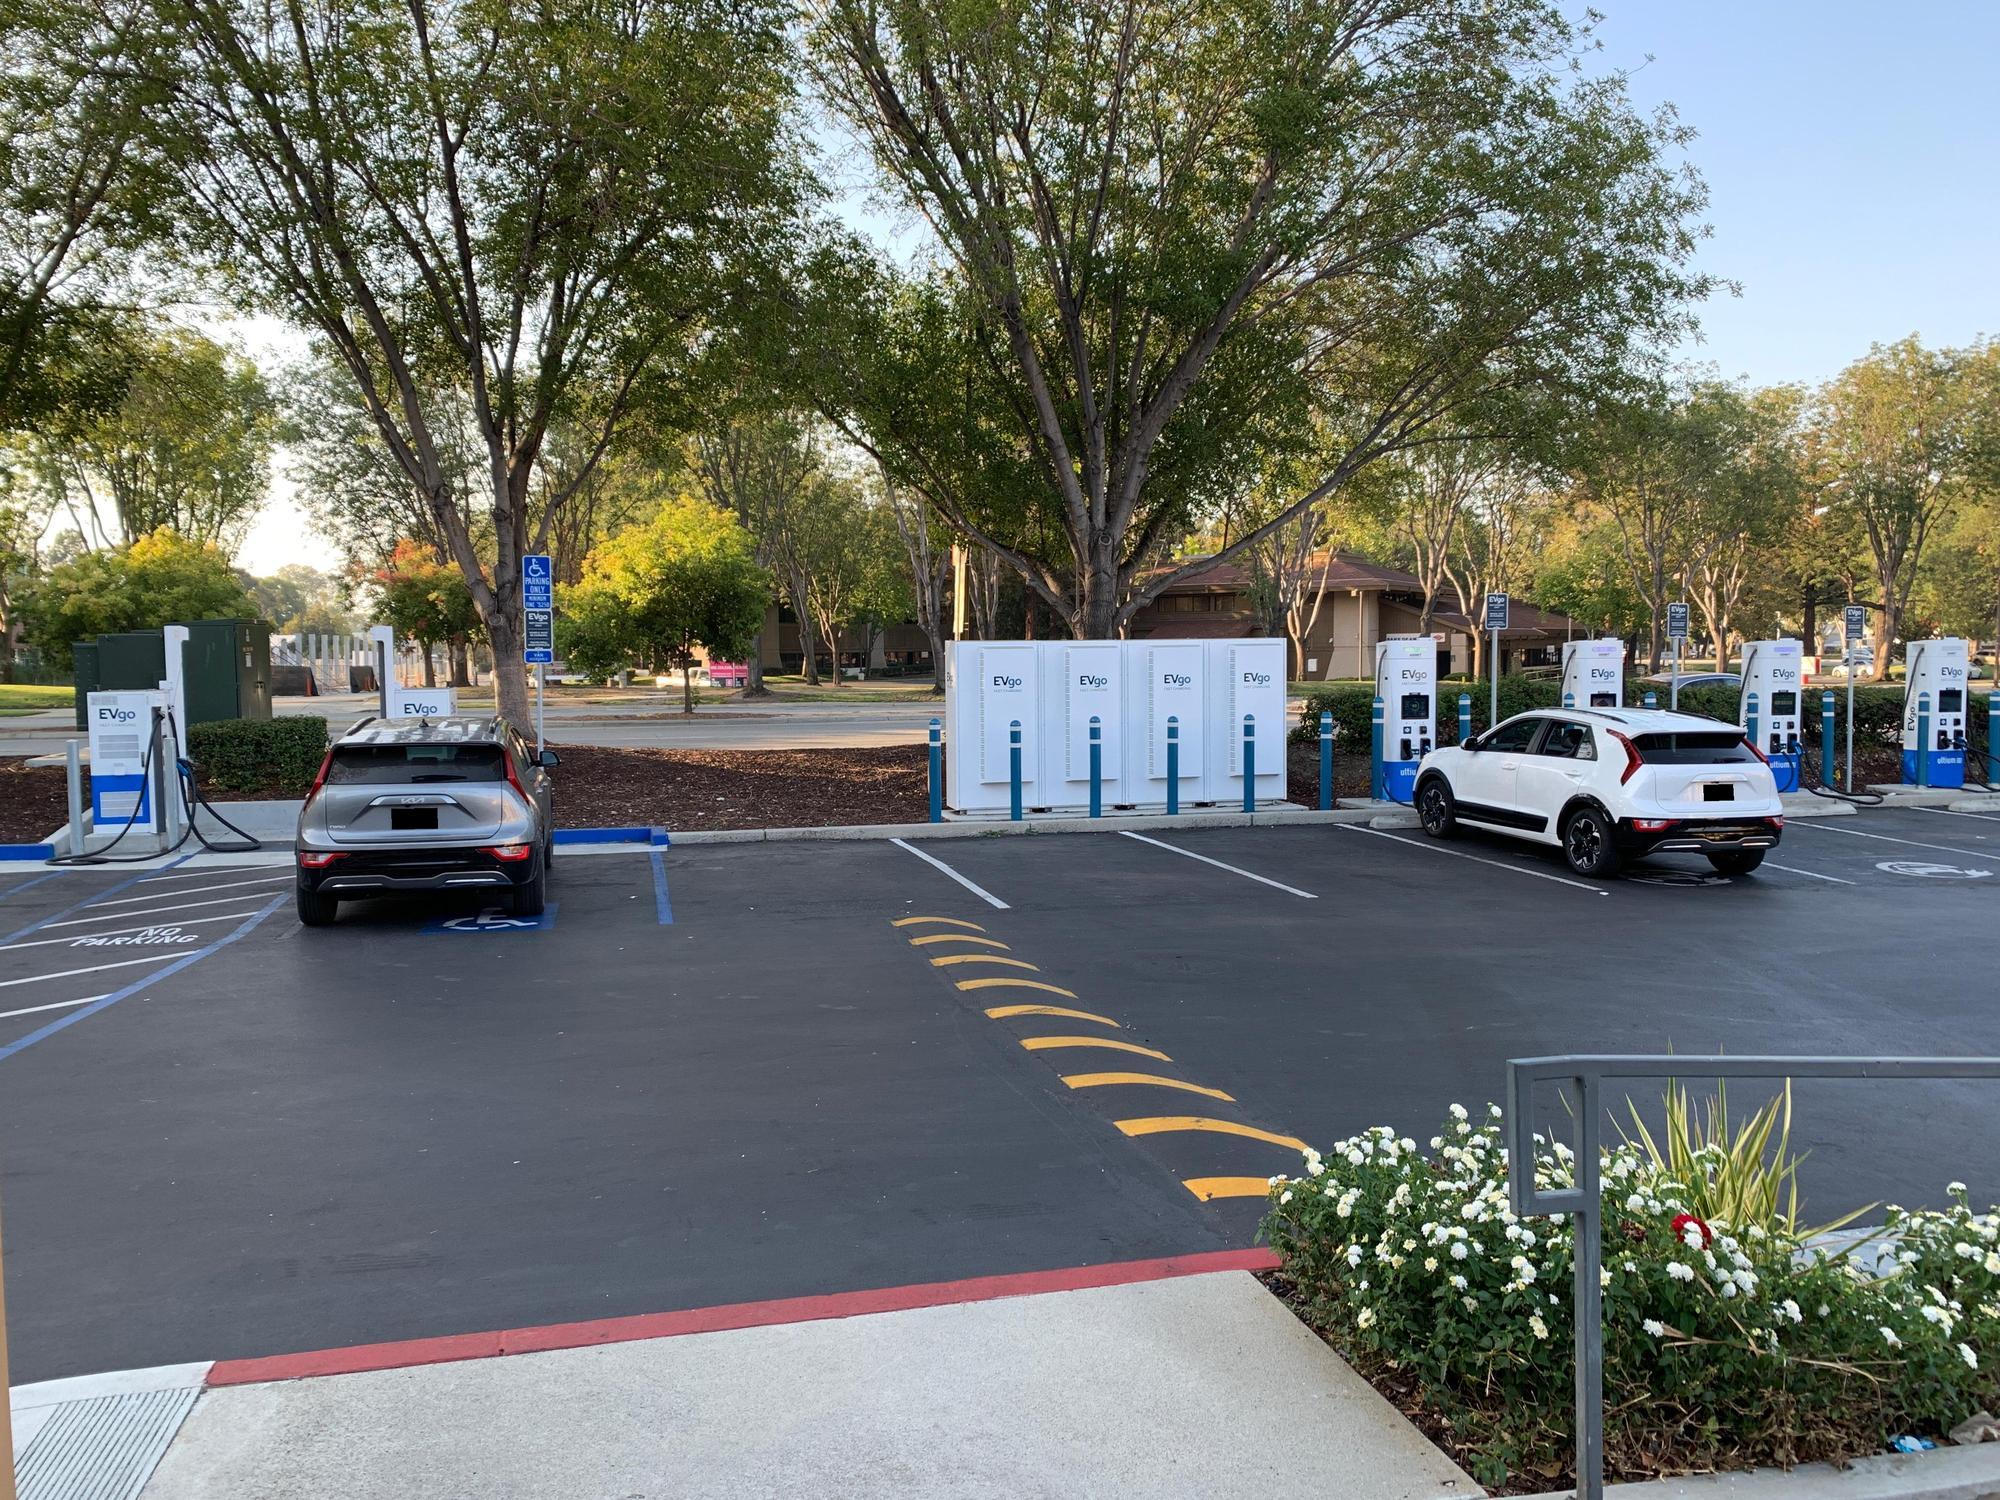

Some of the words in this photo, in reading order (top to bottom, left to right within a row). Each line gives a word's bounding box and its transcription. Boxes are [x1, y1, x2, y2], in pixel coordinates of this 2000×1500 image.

[525, 577, 549, 585] PARKING
[529, 585, 545, 594] ONLY
[1488, 596, 1505, 604] EVgo
[1671, 605, 1686, 613] EVgo
[528, 613, 548, 621] EVgo
[1243, 672, 1270, 685] EVgo
[1402, 669, 1427, 681] EVgo
[1591, 668, 1615, 680] EVgo
[1773, 669, 1795, 680] EVgo
[1941, 667, 1963, 678] EVgo
[993, 676, 1022, 688] EVgo
[1079, 675, 1107, 687] EVgo
[1164, 674, 1191, 686] EVgo
[99, 708, 136, 722] EVgo
[404, 703, 438, 717] EVgo
[1907, 706, 1917, 731] EVgo
[1400, 768, 1417, 776] ultiu
[138, 927, 182, 937] NO
[69, 934, 199, 947] PARKING
